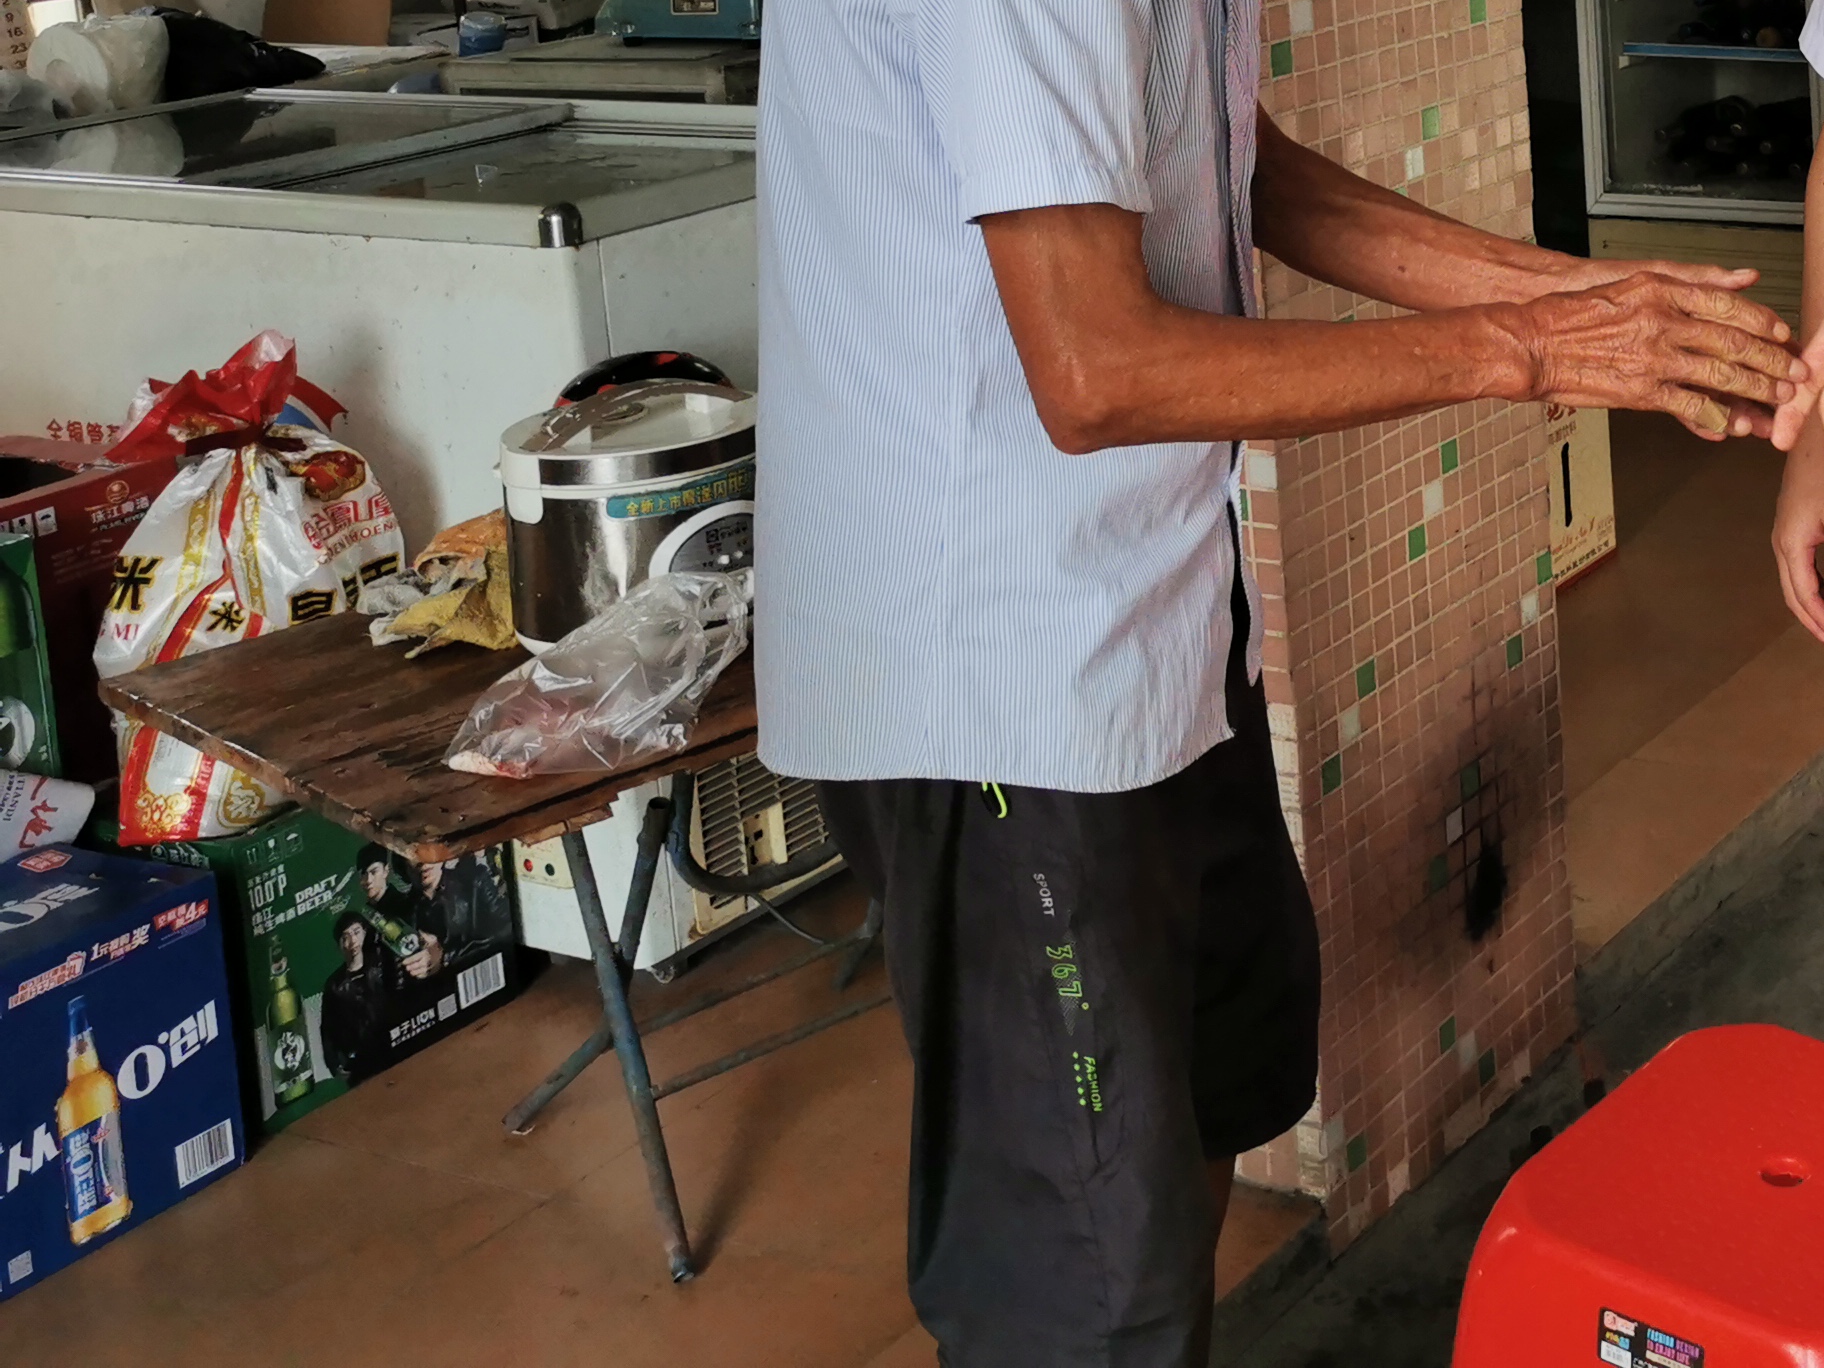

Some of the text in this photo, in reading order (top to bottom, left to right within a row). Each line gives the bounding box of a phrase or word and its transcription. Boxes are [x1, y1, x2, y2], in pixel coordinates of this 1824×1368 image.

[294, 873, 339, 904] DRAFT
[296, 889, 333, 916] BEER
[1032, 872, 1055, 918] SPORT
[1082, 1055, 1103, 1112] FASHION
